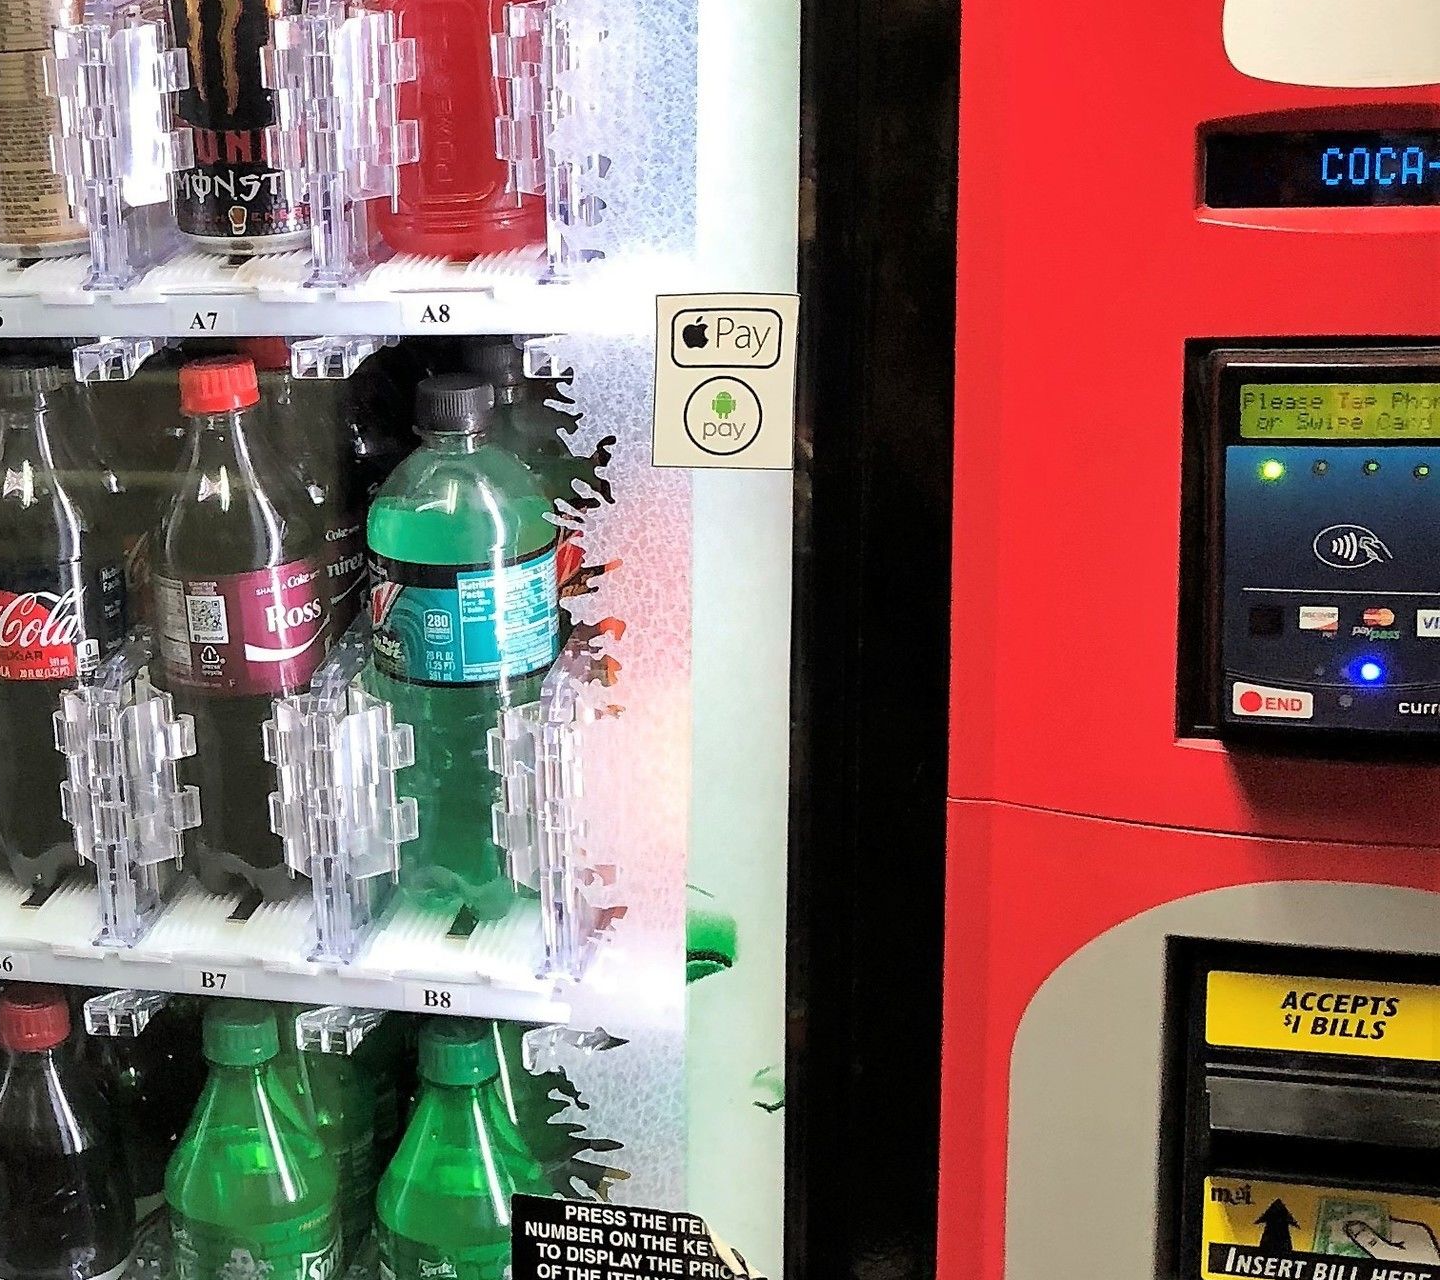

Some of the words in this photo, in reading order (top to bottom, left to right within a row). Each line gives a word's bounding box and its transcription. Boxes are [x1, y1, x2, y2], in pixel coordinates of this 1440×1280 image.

[1321, 147, 1440, 185] COCA-
[190, 312, 217, 330] A7
[420, 304, 450, 323] A8
[716, 317, 771, 358] Pay
[1243, 392, 1323, 410] Please
[1337, 392, 1377, 409] Tap
[1297, 412, 1363, 430] Swipe
[1377, 413, 1433, 430] Card
[703, 422, 746, 441] pay
[288, 573, 310, 588] Coke
[265, 597, 322, 633] Ross
[428, 615, 448, 627] 280
[436, 652, 443, 660] FL
[1265, 697, 1303, 711] END
[201, 971, 227, 989] B7
[423, 990, 451, 1008] B8
[1281, 991, 1401, 1017] ACCEPTS
[1310, 1017, 1387, 1040] BILLS
[565, 1205, 627, 1227] PRESS
[630, 1212, 667, 1231] THE
[525, 1221, 604, 1244] NUMBER
[609, 1231, 637, 1248] ON
[640, 1234, 677, 1253] THE
[536, 1242, 561, 1259] TO
[566, 1246, 643, 1269] DISPLAY
[646, 1255, 683, 1274] THE
[689, 1260, 747, 1280] PRIC
[1226, 1247, 1308, 1280] INSERT
[537, 1263, 562, 1280] OF
